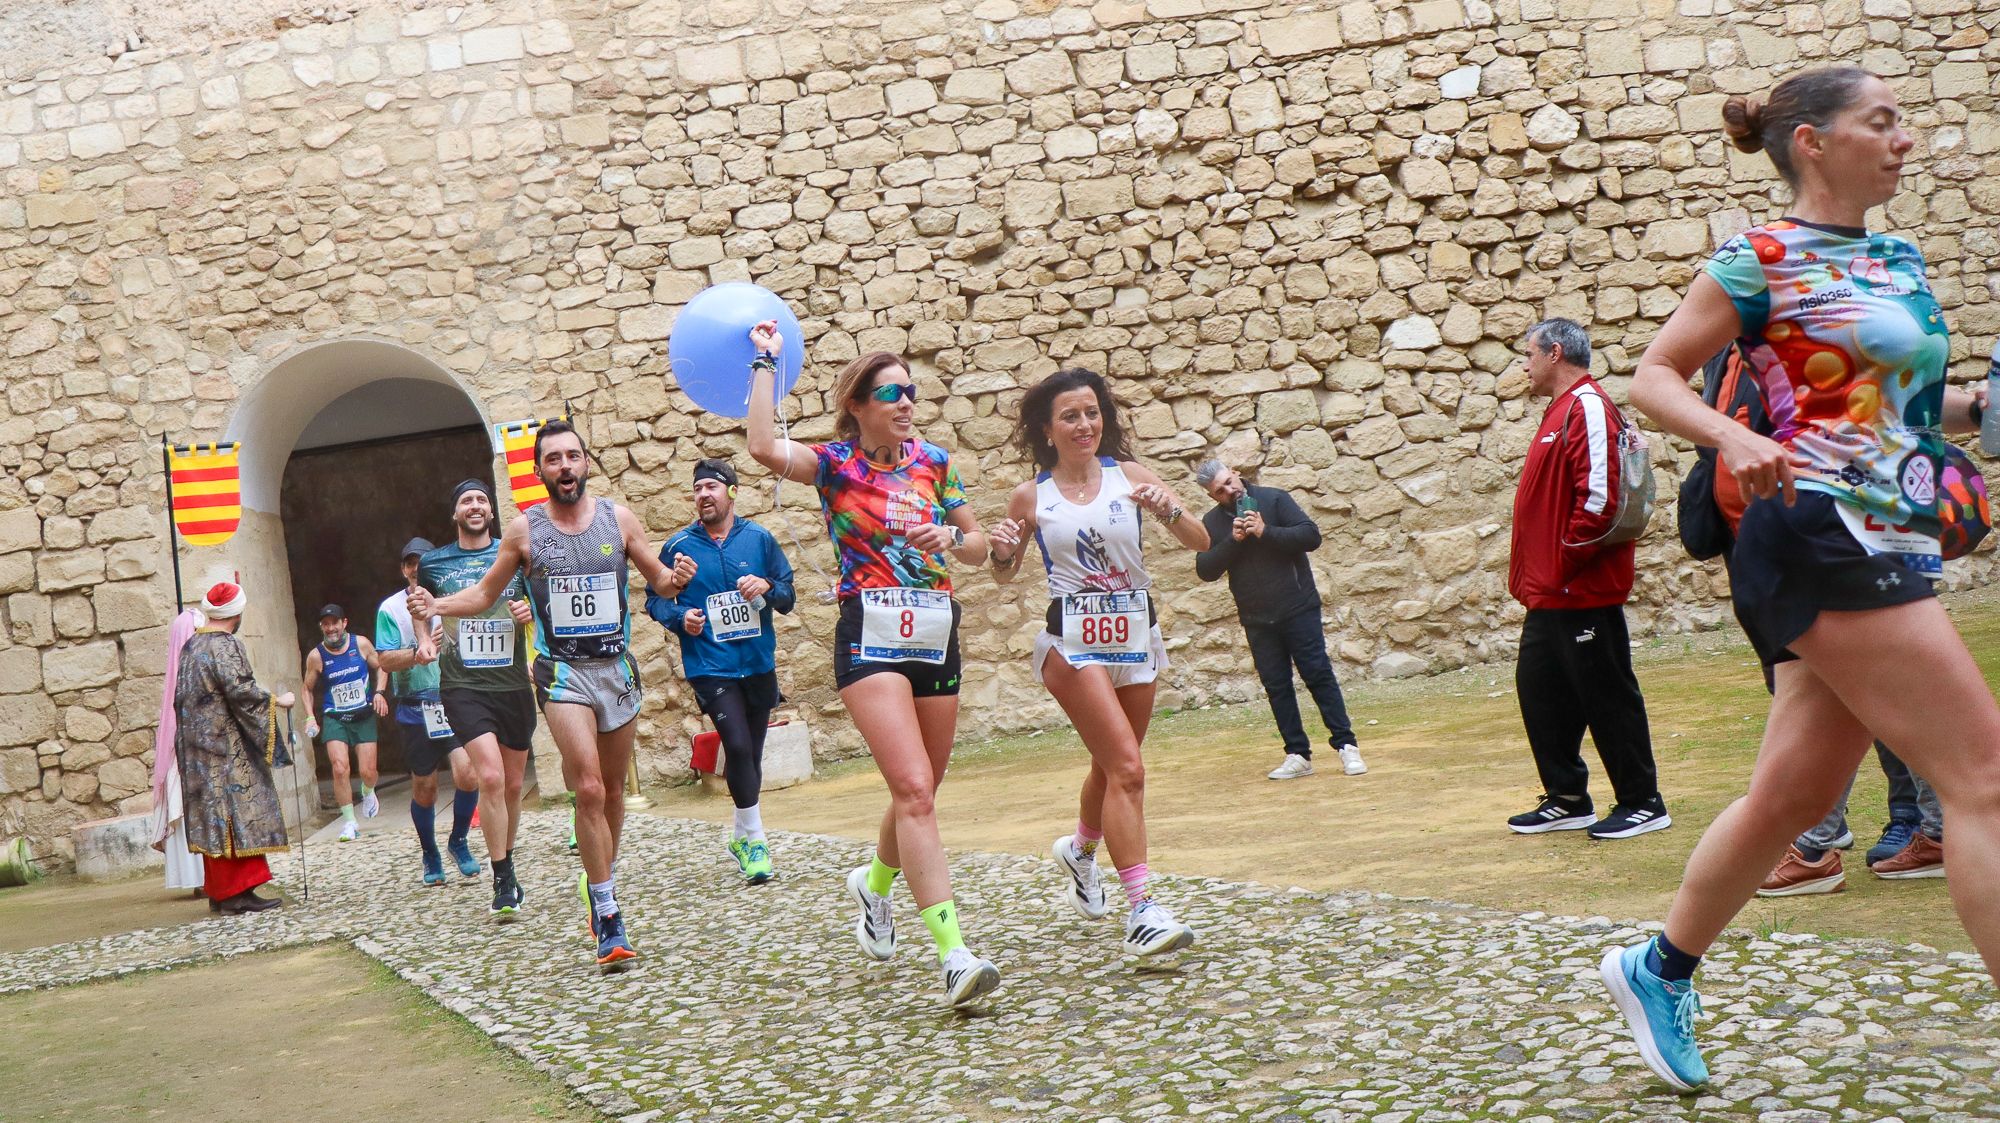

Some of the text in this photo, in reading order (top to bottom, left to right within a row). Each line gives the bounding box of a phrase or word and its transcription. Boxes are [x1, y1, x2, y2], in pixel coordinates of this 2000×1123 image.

[571, 594, 596, 618] 66
[721, 605, 750, 625] 808
[900, 609, 914, 638] 8
[1082, 616, 1129, 645] 869
[467, 635, 505, 652] 1111
[337, 689, 361, 703] 1240
